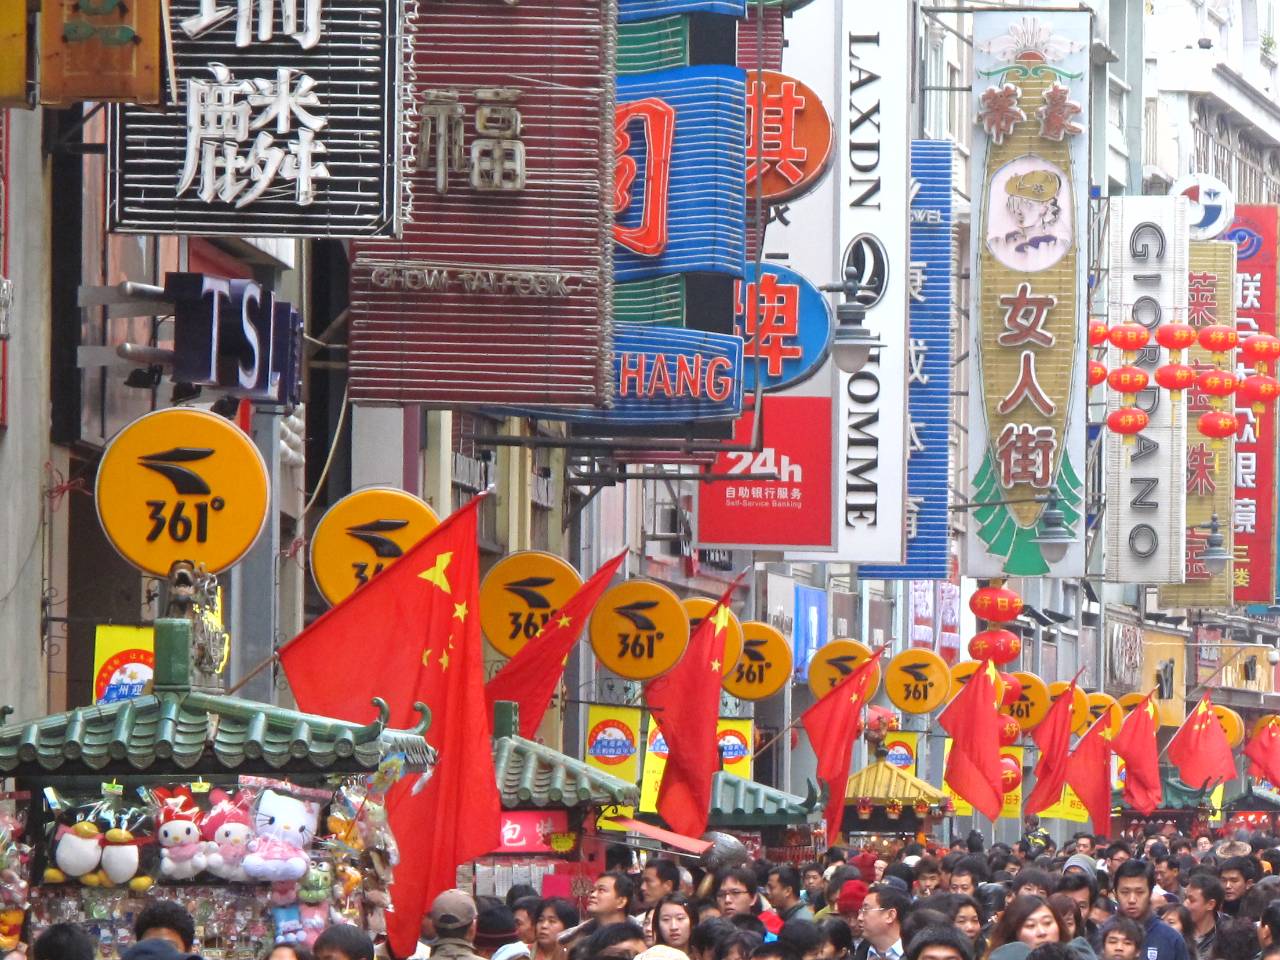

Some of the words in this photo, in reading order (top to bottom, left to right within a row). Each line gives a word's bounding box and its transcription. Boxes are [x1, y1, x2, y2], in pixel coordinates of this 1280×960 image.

[416, 88, 528, 195] 福
[847, 31, 882, 211] LAXDN
[201, 276, 281, 396] TSL
[619, 352, 733, 401] HANG
[997, 282, 1058, 490] 女人街
[1128, 221, 1167, 559] GIORDANO
[726, 486, 802, 499] 自助银行服务
[771, 500, 802, 510] Banking
[146, 496, 225, 543] 361°
[617, 631, 665, 659] 361°
[903, 681, 934, 701] 361°
